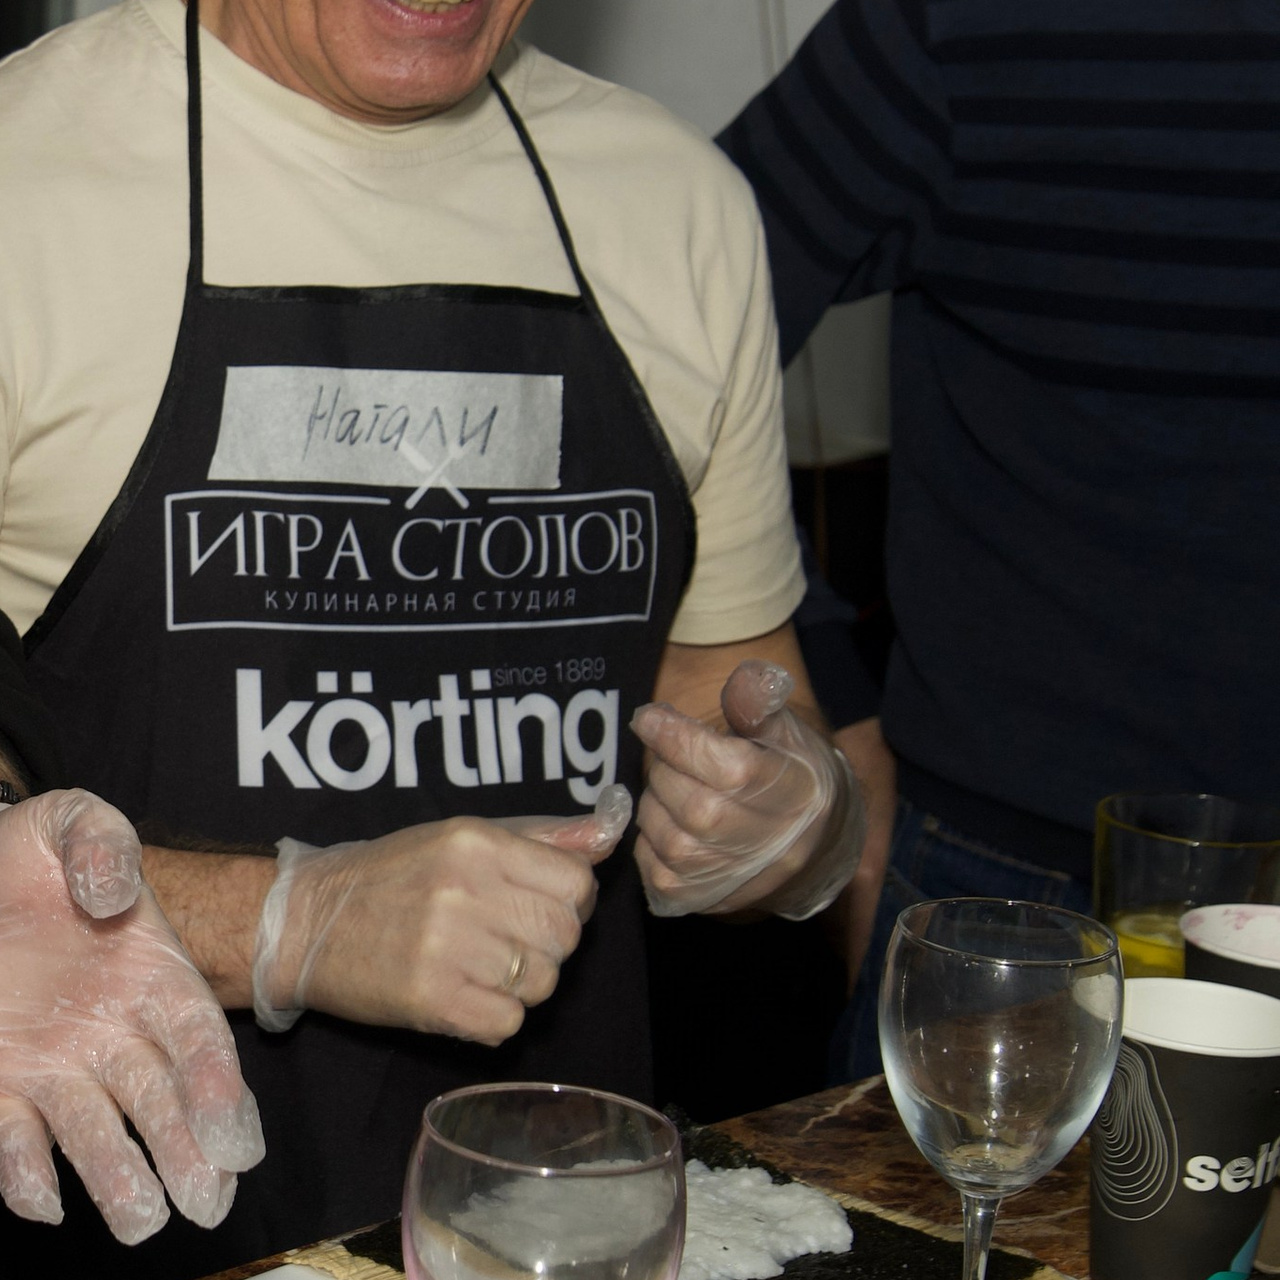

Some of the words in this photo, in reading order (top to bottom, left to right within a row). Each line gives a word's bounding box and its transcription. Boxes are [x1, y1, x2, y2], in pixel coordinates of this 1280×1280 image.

[302, 384, 498, 461] Натали
[185, 510, 372, 582] ИГРА
[391, 506, 645, 582] СТОЛОВ
[264, 588, 457, 613] КУЛИНАРНАЯ
[472, 586, 577, 612] СТУДИЯ
[493, 662, 548, 688] since
[555, 657, 606, 684] 1889
[235, 667, 619, 806] körting
[1183, 1136, 1280, 1193] self
